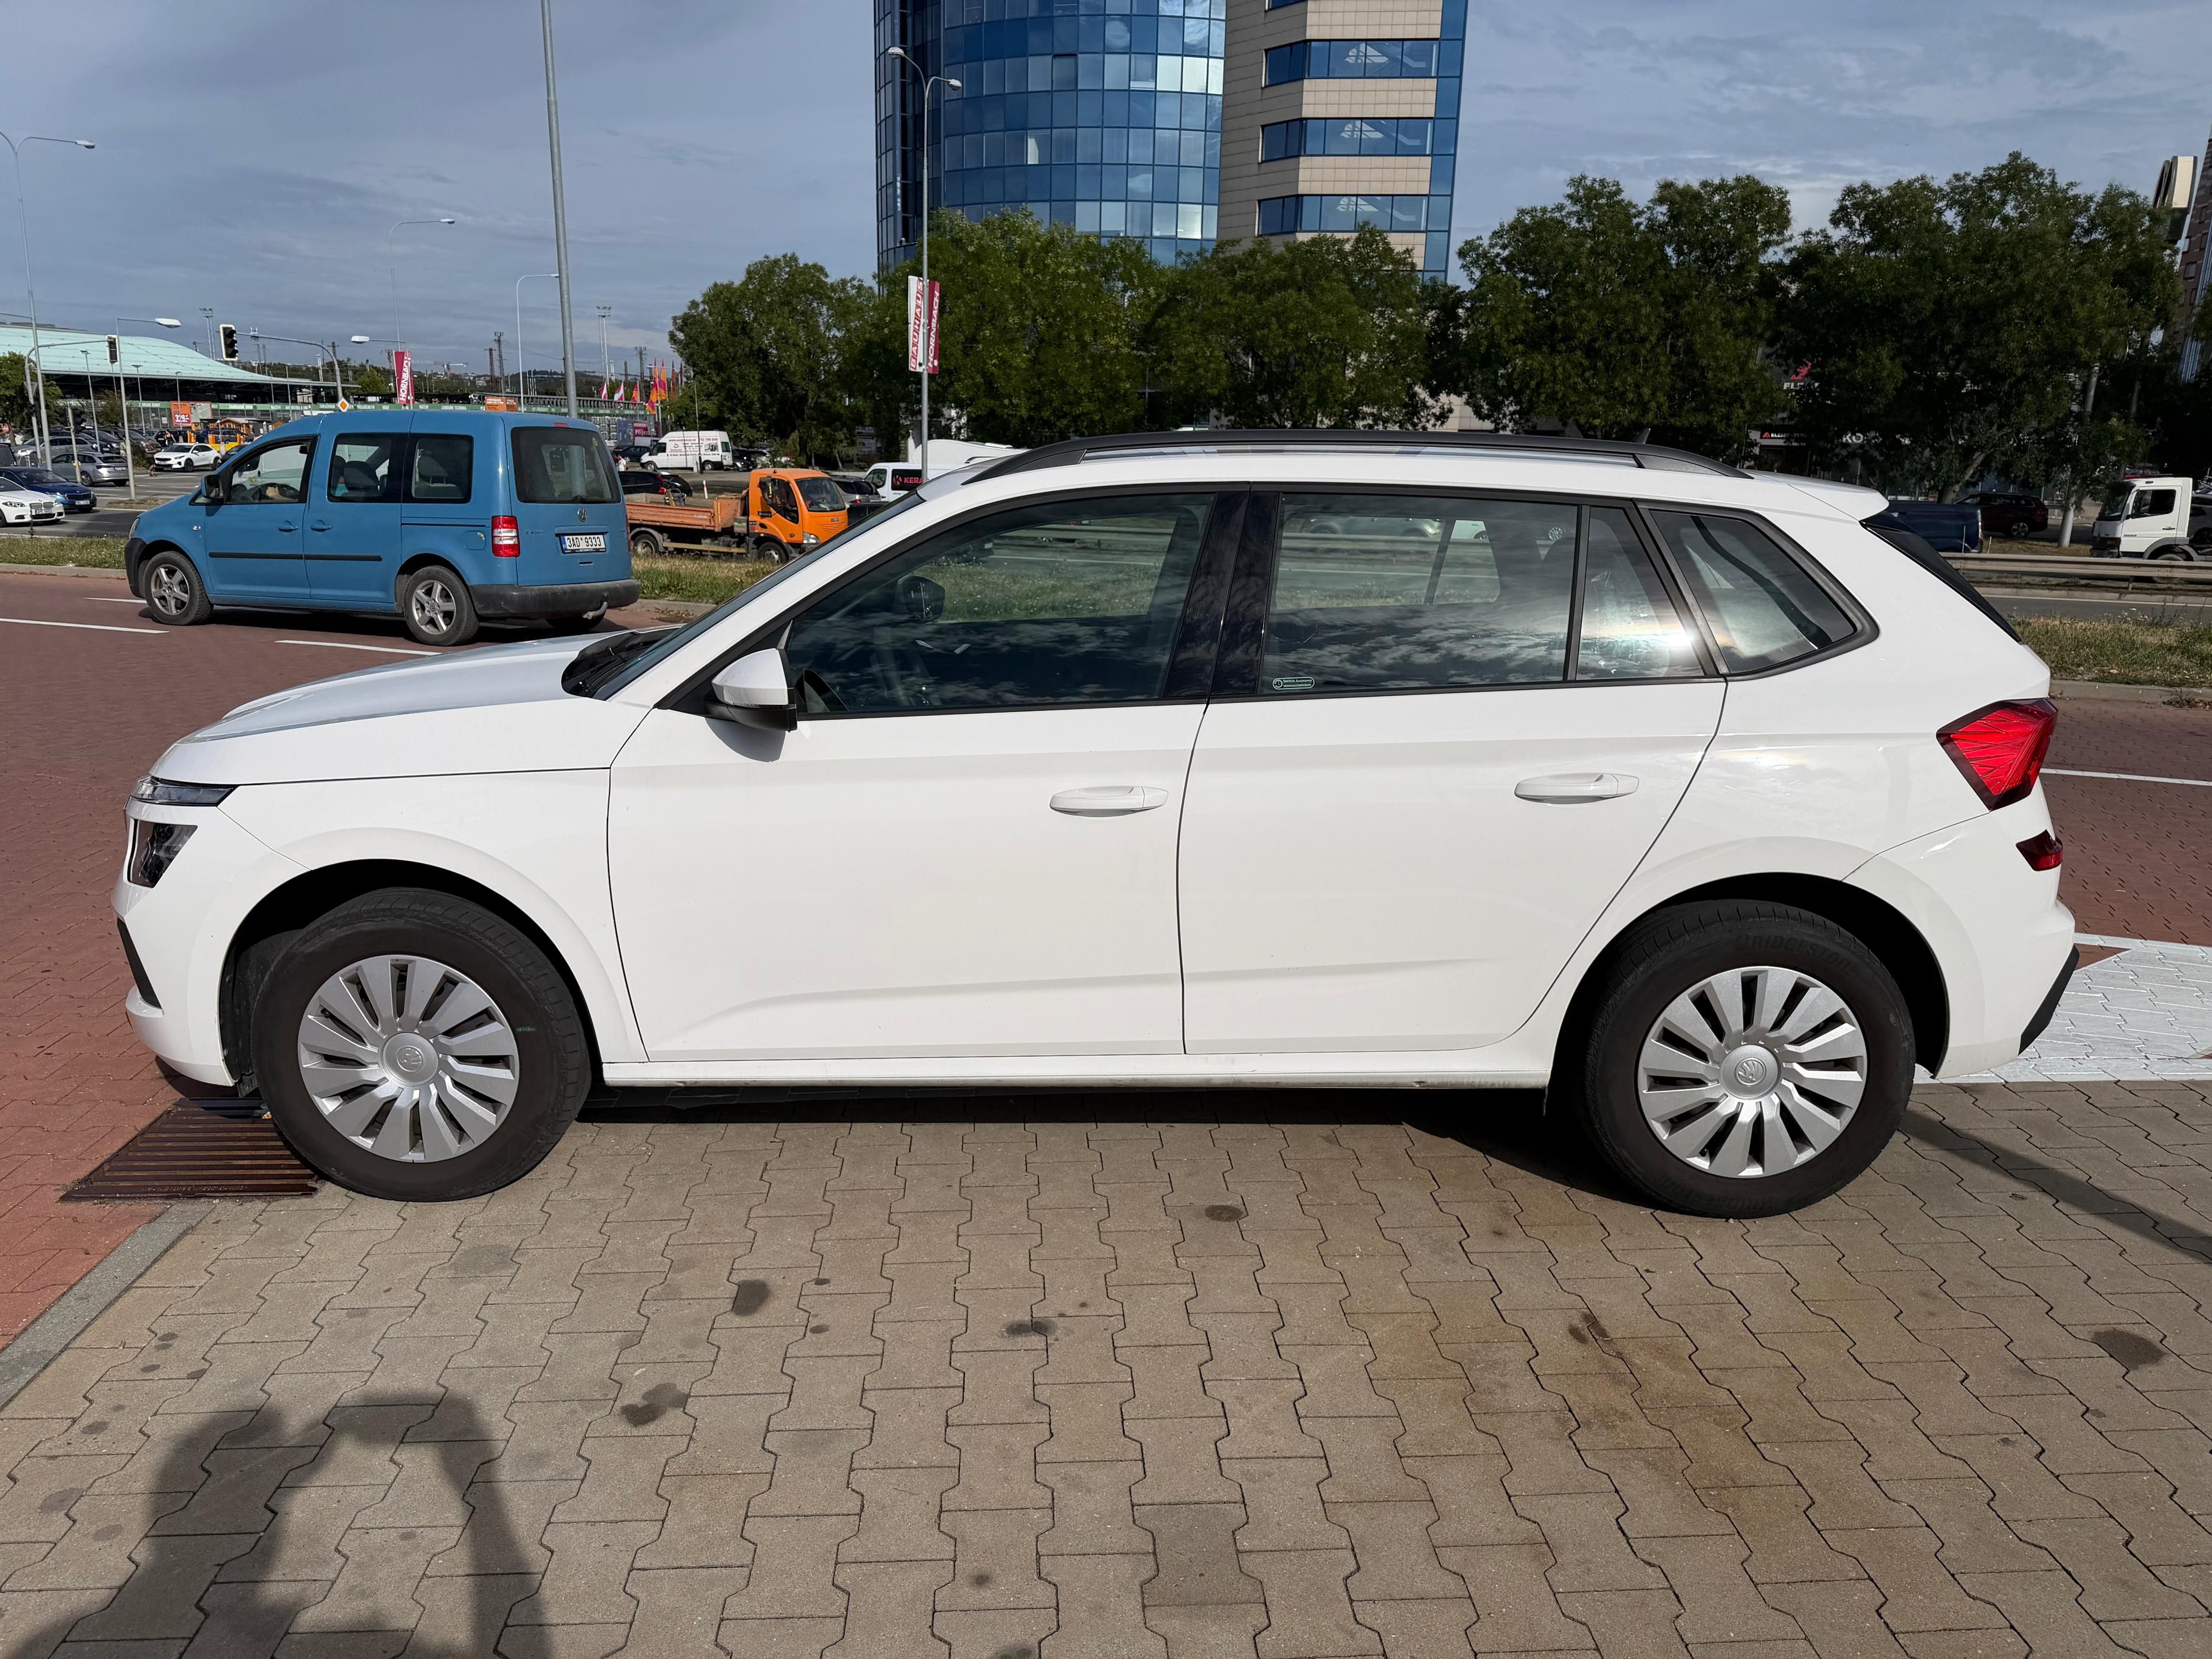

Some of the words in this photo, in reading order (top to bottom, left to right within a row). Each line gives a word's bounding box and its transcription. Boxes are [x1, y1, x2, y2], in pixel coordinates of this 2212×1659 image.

[910, 277, 925, 371] BAUHAUS
[928, 290, 940, 368] HORNBACH
[400, 356, 410, 401] HORNBAC
[567, 536, 581, 548] 3AD
[585, 536, 602, 547] 9333
